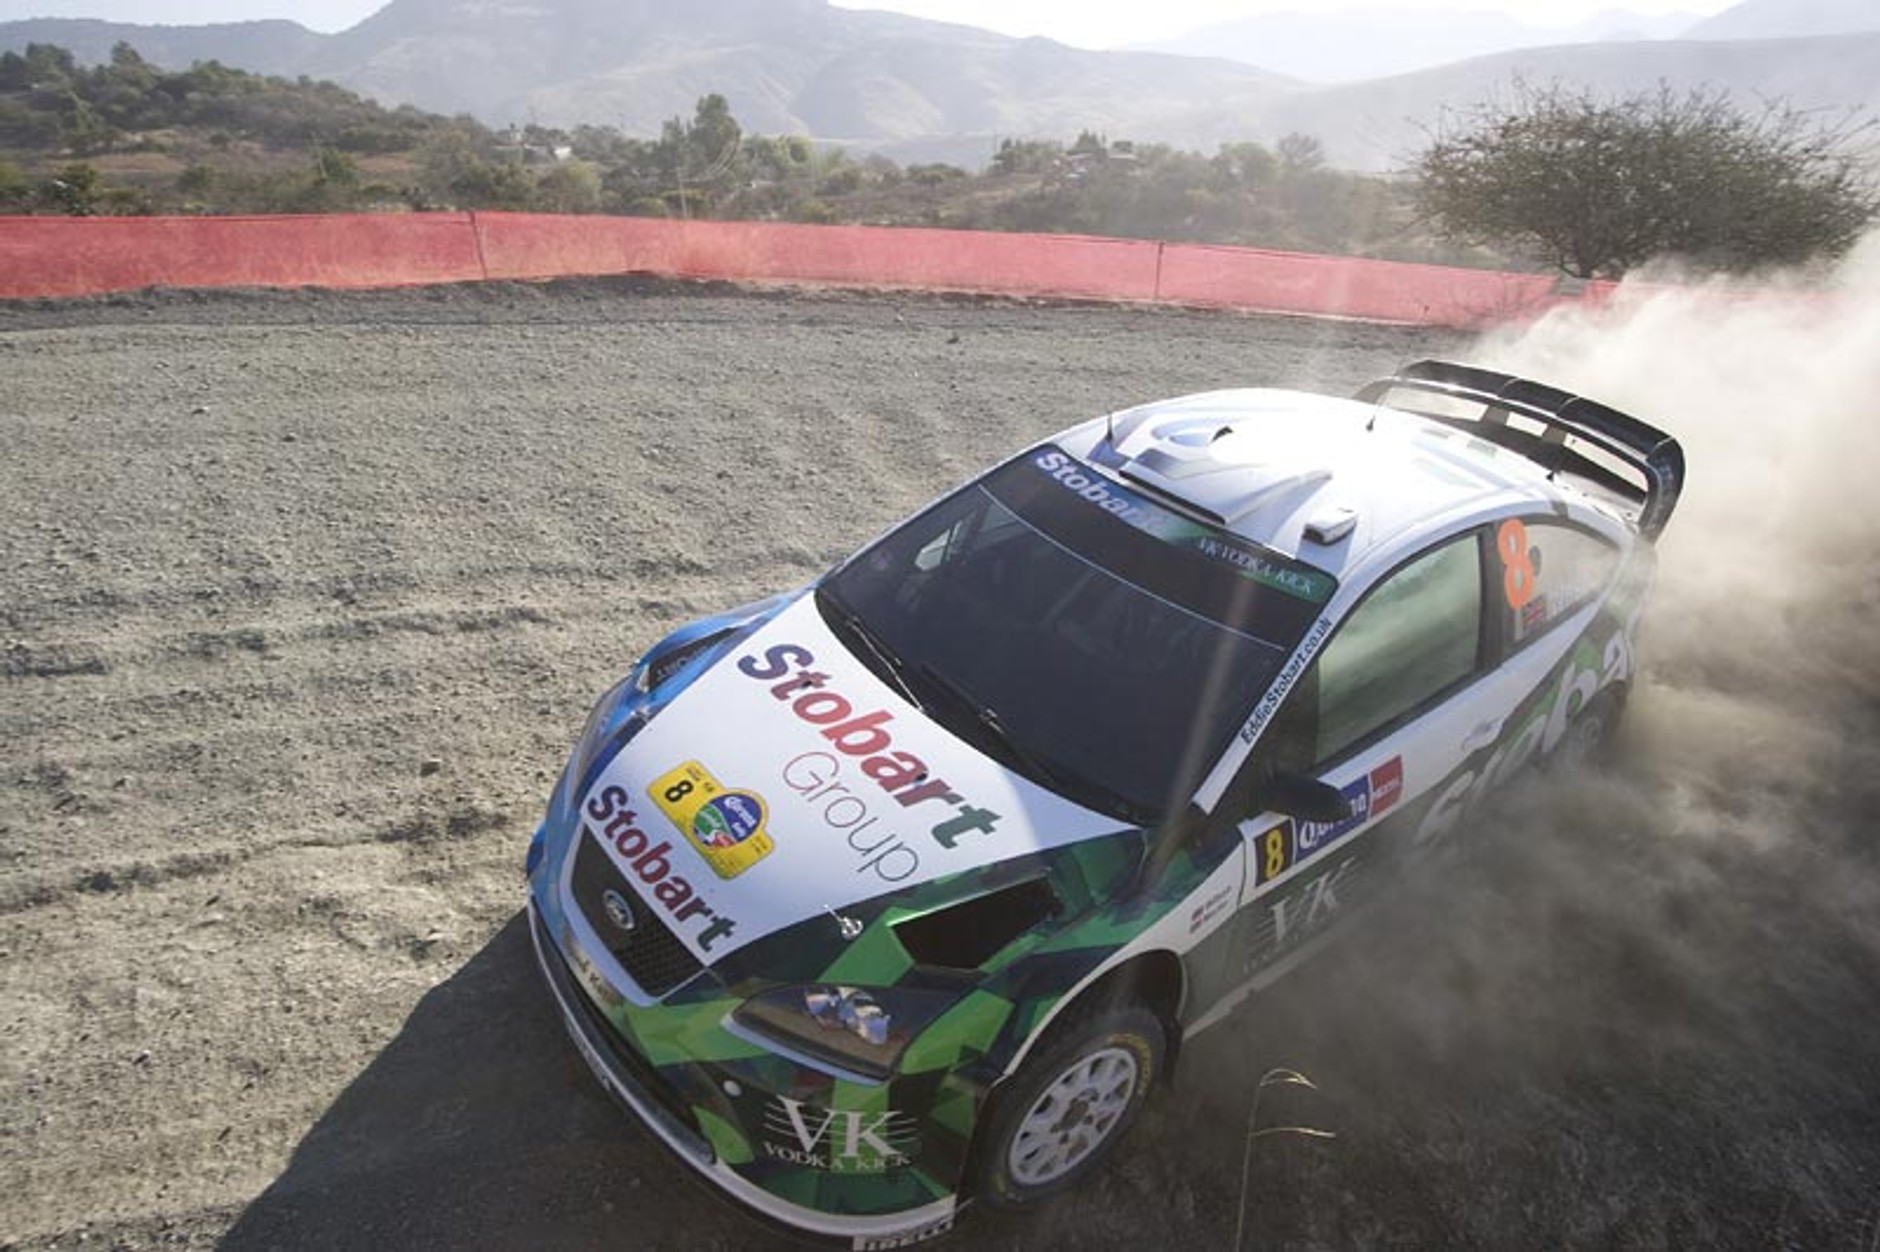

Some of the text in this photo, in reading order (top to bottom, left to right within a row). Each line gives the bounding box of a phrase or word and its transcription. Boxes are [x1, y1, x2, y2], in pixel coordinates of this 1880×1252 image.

[1498, 518, 1534, 609] 8
[1240, 617, 1332, 745] EddieStobart.co.uk
[664, 780, 694, 803] 8
[737, 643, 1004, 850] Stobart
[782, 752, 919, 885] Group
[1266, 829, 1284, 880] 8
[588, 784, 738, 952] Stobart
[763, 1142, 912, 1169] VODKA KICK
[777, 1095, 904, 1157] VK
